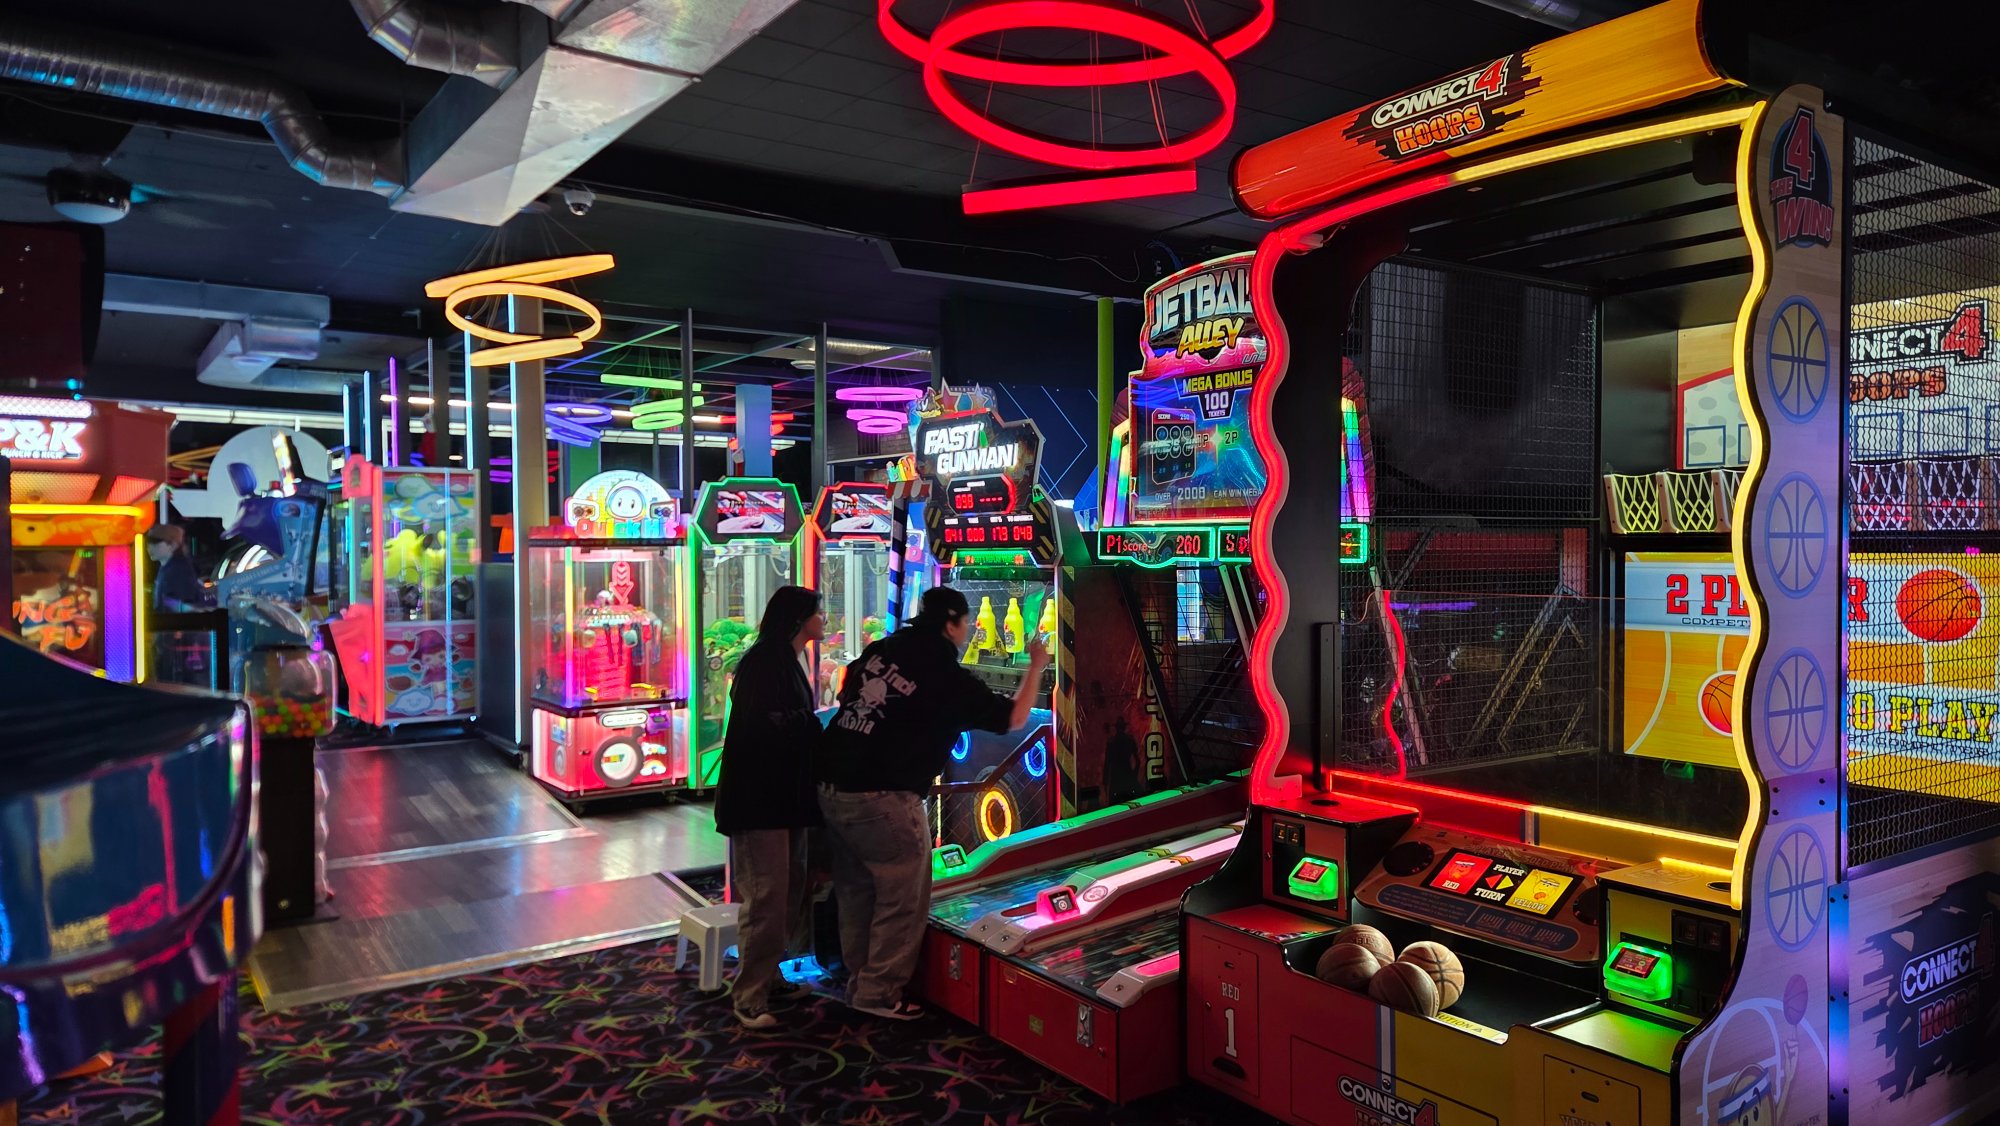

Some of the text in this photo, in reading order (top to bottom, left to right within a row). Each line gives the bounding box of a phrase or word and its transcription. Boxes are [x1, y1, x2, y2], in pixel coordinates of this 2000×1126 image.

[1374, 57, 1506, 125] CONNECT 4
[1395, 104, 1483, 152] HOOPS
[1786, 115, 1813, 183] 4
[1770, 177, 1793, 199] THE
[1777, 197, 1833, 243] WIN!
[1151, 268, 1254, 340] JETBAL
[1177, 317, 1245, 357] ALLEY
[1850, 306, 1985, 361] NECT 4
[1182, 369, 1252, 394] MEGA BONUS
[1849, 366, 1946, 402] OOPS
[1204, 391, 1230, 411] 100
[1208, 409, 1226, 418] TICKETS
[924, 423, 980, 454] FAST
[1224, 431, 1238, 445] 2P
[1106, 534, 1122, 554] P1
[1176, 535, 1201, 555] 260
[1667, 574, 1689, 614] 2
[1681, 617, 1750, 627] COMPET
[1889, 695, 1998, 742] PLAY
[1441, 880, 1460, 890] RED
[1493, 864, 1525, 877] PLAYER
[1474, 887, 1506, 902] TURN
[1511, 897, 1548, 912] YELLOW
[1902, 940, 1978, 998] CONNECT
[1221, 982, 1240, 1001] RED
[1225, 1008, 1237, 1058] 1
[1340, 1078, 1417, 1122] CONNECT
